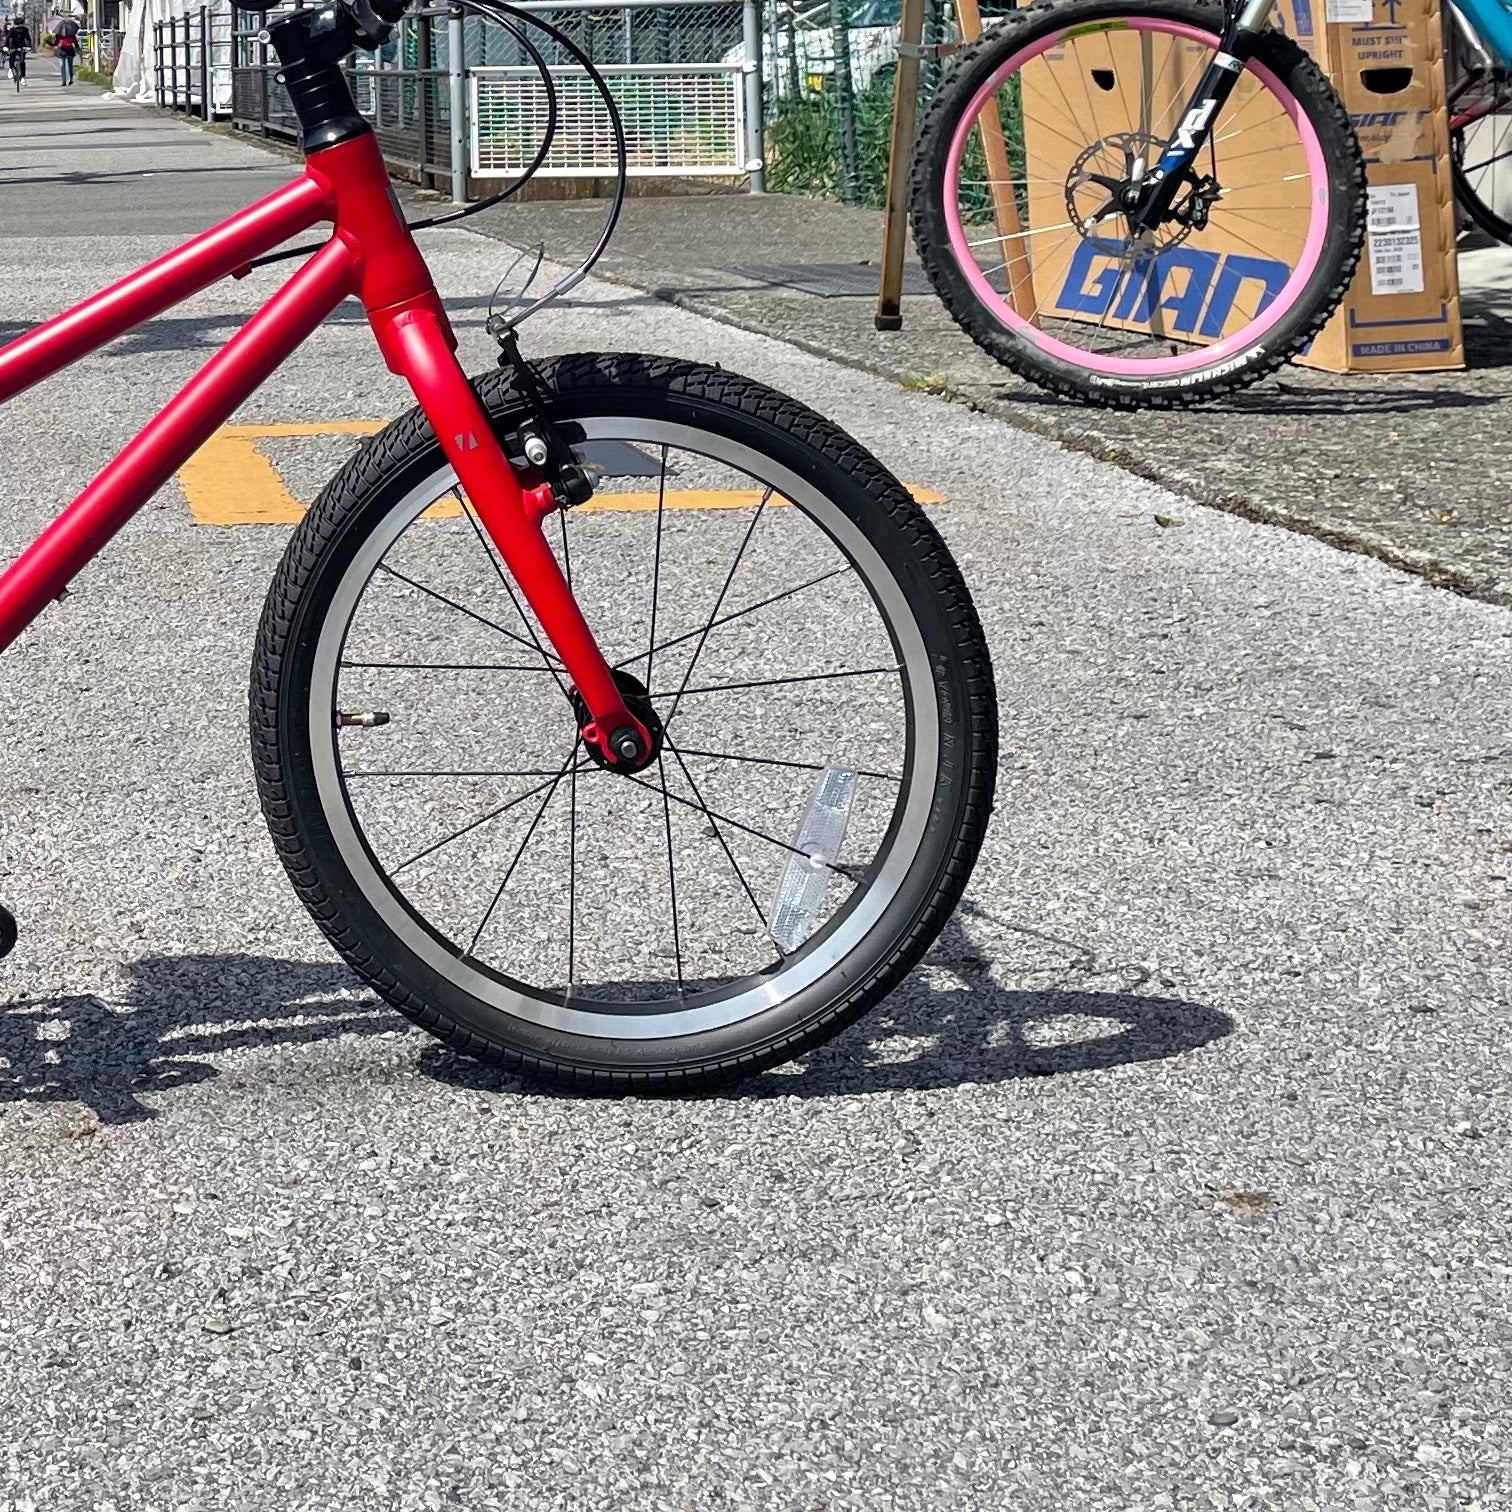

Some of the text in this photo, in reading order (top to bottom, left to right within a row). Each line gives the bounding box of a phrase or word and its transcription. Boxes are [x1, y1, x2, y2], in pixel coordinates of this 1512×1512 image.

[1352, 36, 1381, 46] MUST
[1357, 49, 1404, 60] UPRIGHT
[1055, 237, 1292, 338] GIAN
[1360, 341, 1441, 355] MADE IN CHINA
